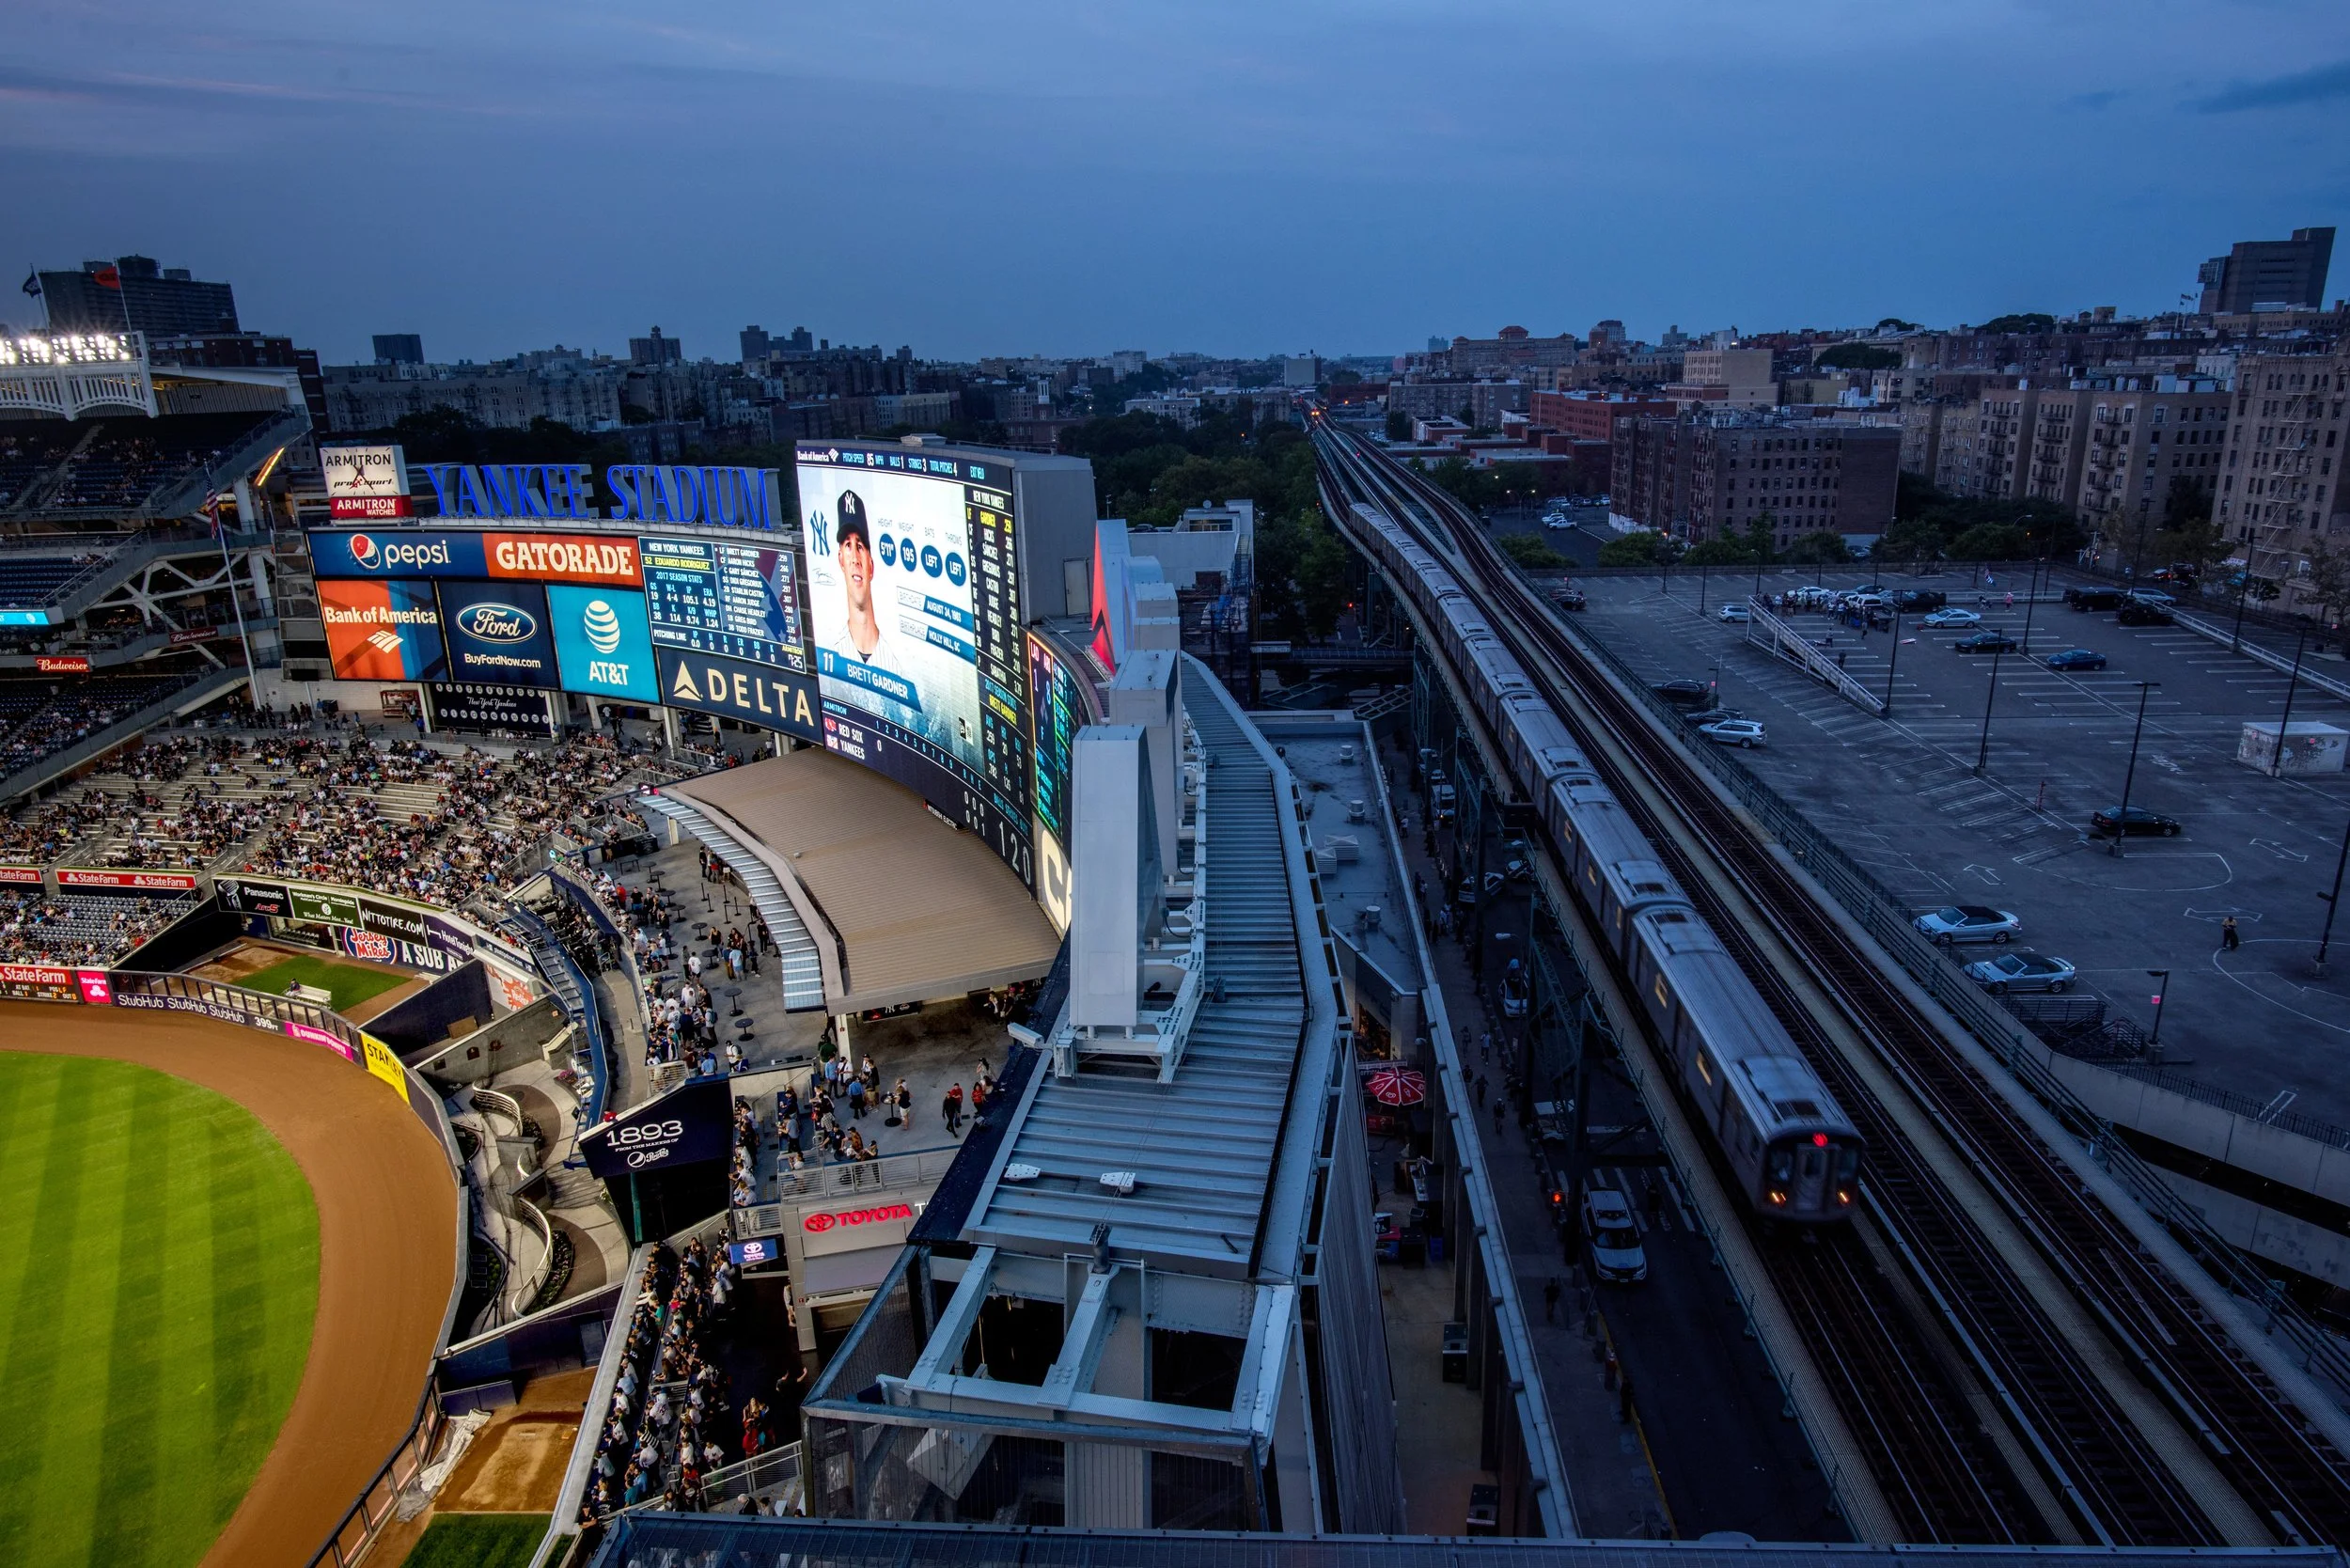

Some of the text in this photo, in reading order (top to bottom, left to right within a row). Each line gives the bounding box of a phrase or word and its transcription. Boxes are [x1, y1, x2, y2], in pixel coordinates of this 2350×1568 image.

[325, 454, 391, 466] ARMITRON
[797, 451, 808, 461] Bank
[813, 451, 829, 462] America
[842, 452, 884, 466] PITCH SPEED 85 MPH
[889, 456, 904, 469] BALLS 1
[908, 458, 927, 472] STRIKES 3
[930, 460, 958, 478] TOTAL PITCHES 4
[337, 498, 396, 510] ARMITRON
[422, 464, 778, 529] YANKEE STADIUM
[384, 541, 449, 570] pepsi
[650, 542, 704, 556] NEW YORK YANKEES
[727, 547, 760, 558] BRETT GARDNER
[902, 546, 915, 563] 195
[496, 541, 634, 575] GATORADE
[655, 557, 680, 567] EDUARDO
[681, 559, 710, 570] RODRIGUEZ
[728, 557, 755, 568] AARON HICKS
[925, 553, 937, 569] LEFT
[949, 560, 962, 577] LEFT
[656, 572, 703, 584] 2017 SEASON STATS
[739, 578, 763, 588] GREGORIUS
[650, 582, 713, 597] GS W-L IP ERA
[731, 587, 765, 599] STARLIN CASTRO
[650, 590, 715, 607] 19 4-4 105.1 4.19
[732, 596, 760, 607] AARON JUDGE
[325, 606, 438, 624] Bank of America
[652, 602, 660, 610] BB
[687, 606, 696, 615] K/9
[704, 608, 716, 618] WHIP
[733, 605, 766, 619] CHASE HEADLEY
[927, 600, 944, 615] AUGUST
[473, 609, 521, 637] Ford
[653, 611, 719, 628] 38 114 9.74 1.24
[734, 616, 758, 626] GREG BIRD
[653, 629, 686, 641] PITCHING LINE
[736, 624, 765, 637] TODD FRAZIER
[691, 639, 700, 648] 0.0
[929, 630, 942, 644] HOLLY
[954, 640, 960, 652] SC
[781, 645, 803, 655] ARMITRON
[1030, 641, 1040, 662] LAD
[37, 659, 88, 670] Budweiser
[464, 653, 541, 669] BuyFordNow.com
[788, 654, 803, 668] 7:25
[823, 651, 834, 673] 11
[588, 661, 629, 686] AT&T
[847, 663, 909, 700] BRETT GARDNER
[1034, 668, 1039, 692] 1
[707, 667, 814, 727] DELTA
[1046, 680, 1052, 705] 8
[479, 697, 494, 709] York
[494, 698, 517, 710] Yankees
[823, 700, 847, 715] ARMITRON
[838, 723, 882, 752] RED SOX 0
[839, 739, 865, 760] YANKEES
[964, 791, 984, 817] 0 0 0
[965, 809, 986, 837] 0 0 1
[999, 821, 1031, 885] 1 2 0
[0, 870, 36, 881] tateFarm
[78, 872, 119, 885] StateFarm
[146, 876, 188, 888] StateFarm
[244, 886, 284, 900] Panasonic
[362, 907, 425, 937] NITTOTIRE.COM
[350, 927, 387, 946] Jersey
[401, 940, 413, 964] A
[415, 946, 444, 969] SUB
[4, 967, 67, 983] StateFarm
[118, 995, 245, 1024] StubHub StubHub StubHub
[327, 1037, 347, 1055] DONUTS
[606, 1120, 683, 1147] 1893
[836, 1203, 913, 1227] TOYOTA
